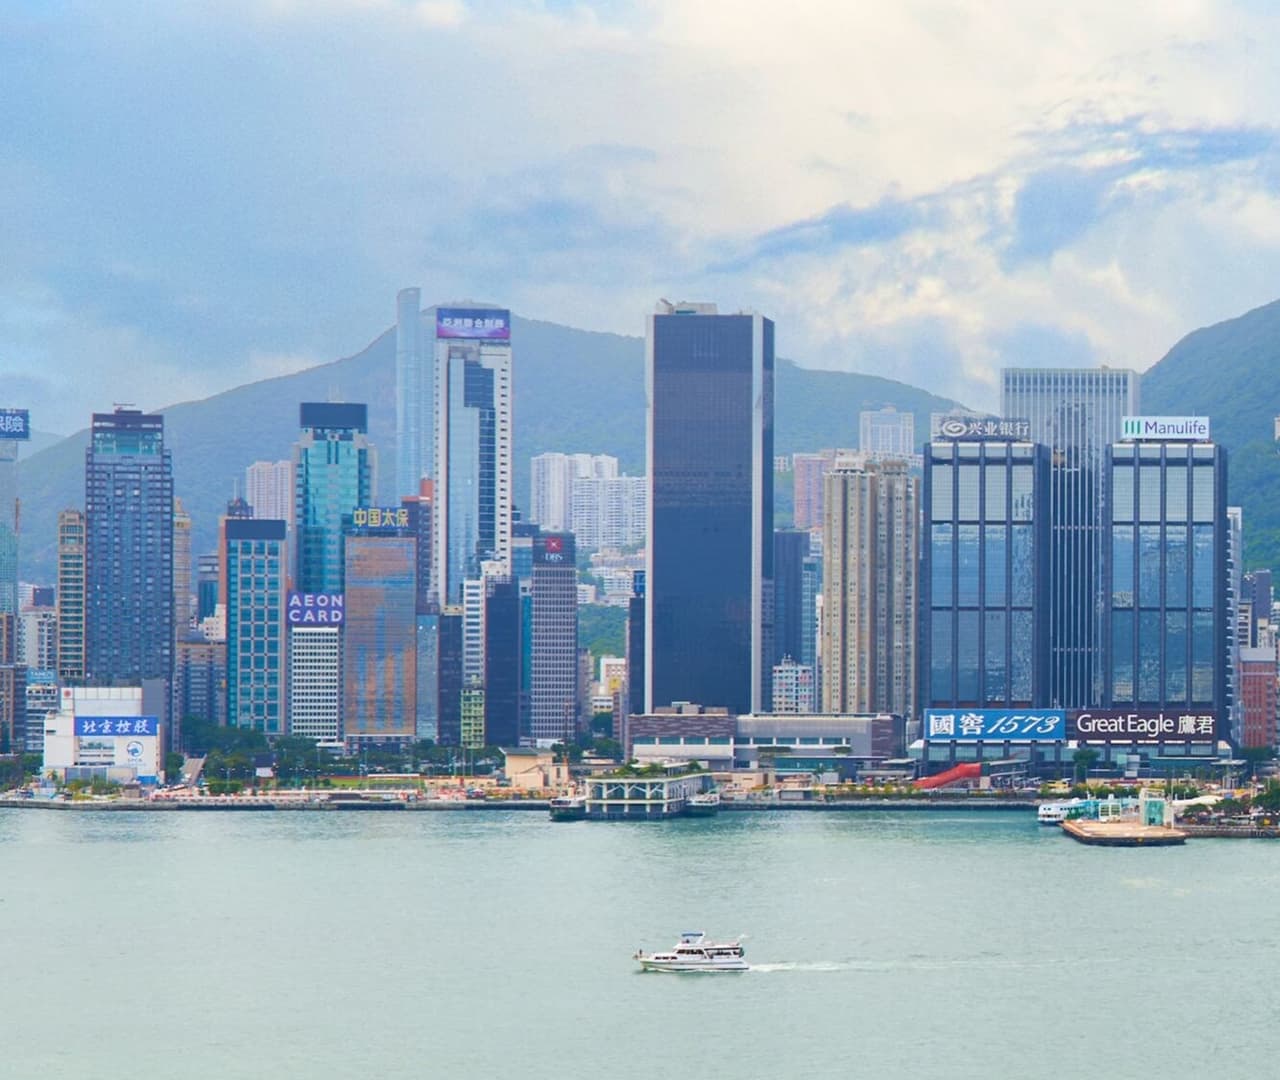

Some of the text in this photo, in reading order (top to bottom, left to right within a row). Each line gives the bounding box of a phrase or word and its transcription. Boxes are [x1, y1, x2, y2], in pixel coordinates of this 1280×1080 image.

[968, 421, 1029, 436] 兴业银行
[1144, 420, 1207, 434] Manulife
[353, 507, 409, 528] 中国太保
[289, 594, 343, 607] AEON
[289, 610, 343, 622] CARD
[82, 719, 151, 734] 北京控股
[1077, 713, 1216, 738] Great Eagle 鷹君
